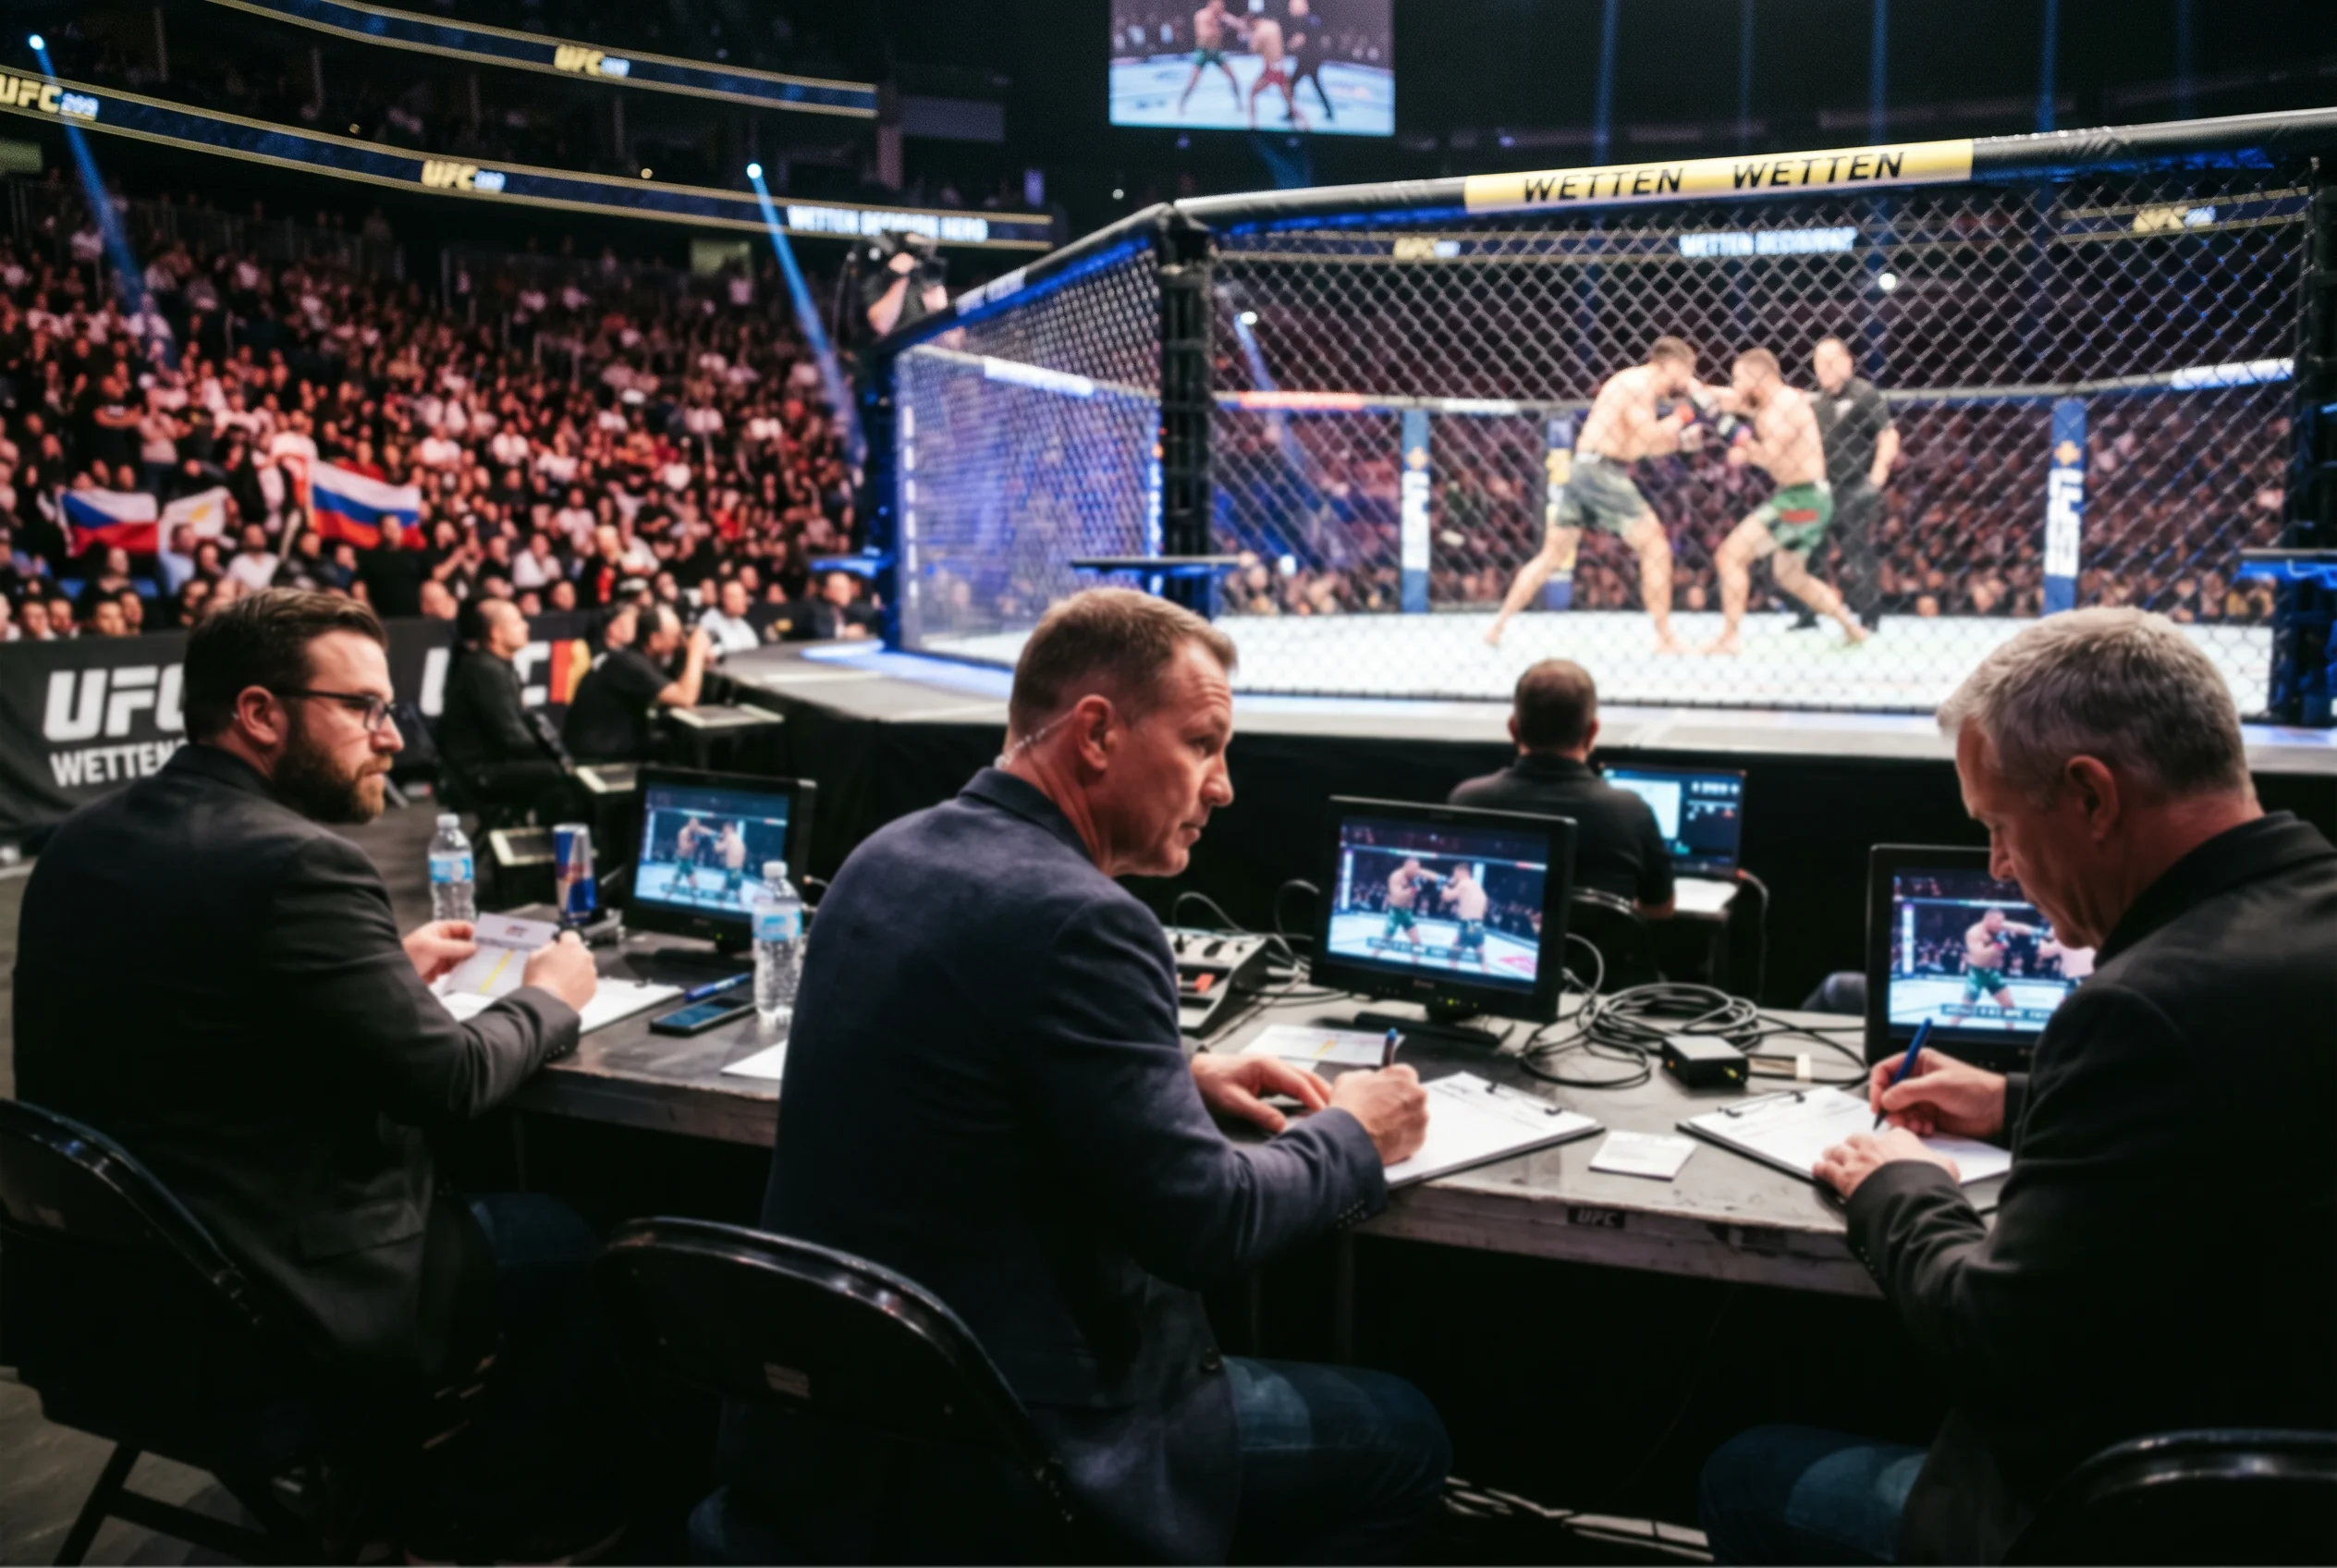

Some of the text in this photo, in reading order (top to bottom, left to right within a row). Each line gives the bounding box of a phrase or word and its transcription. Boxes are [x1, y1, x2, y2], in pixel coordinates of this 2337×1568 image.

[0, 74, 63, 114] UFC
[1524, 152, 1904, 203] WETTEN WETTEN
[49, 738, 189, 788] WETTEN
